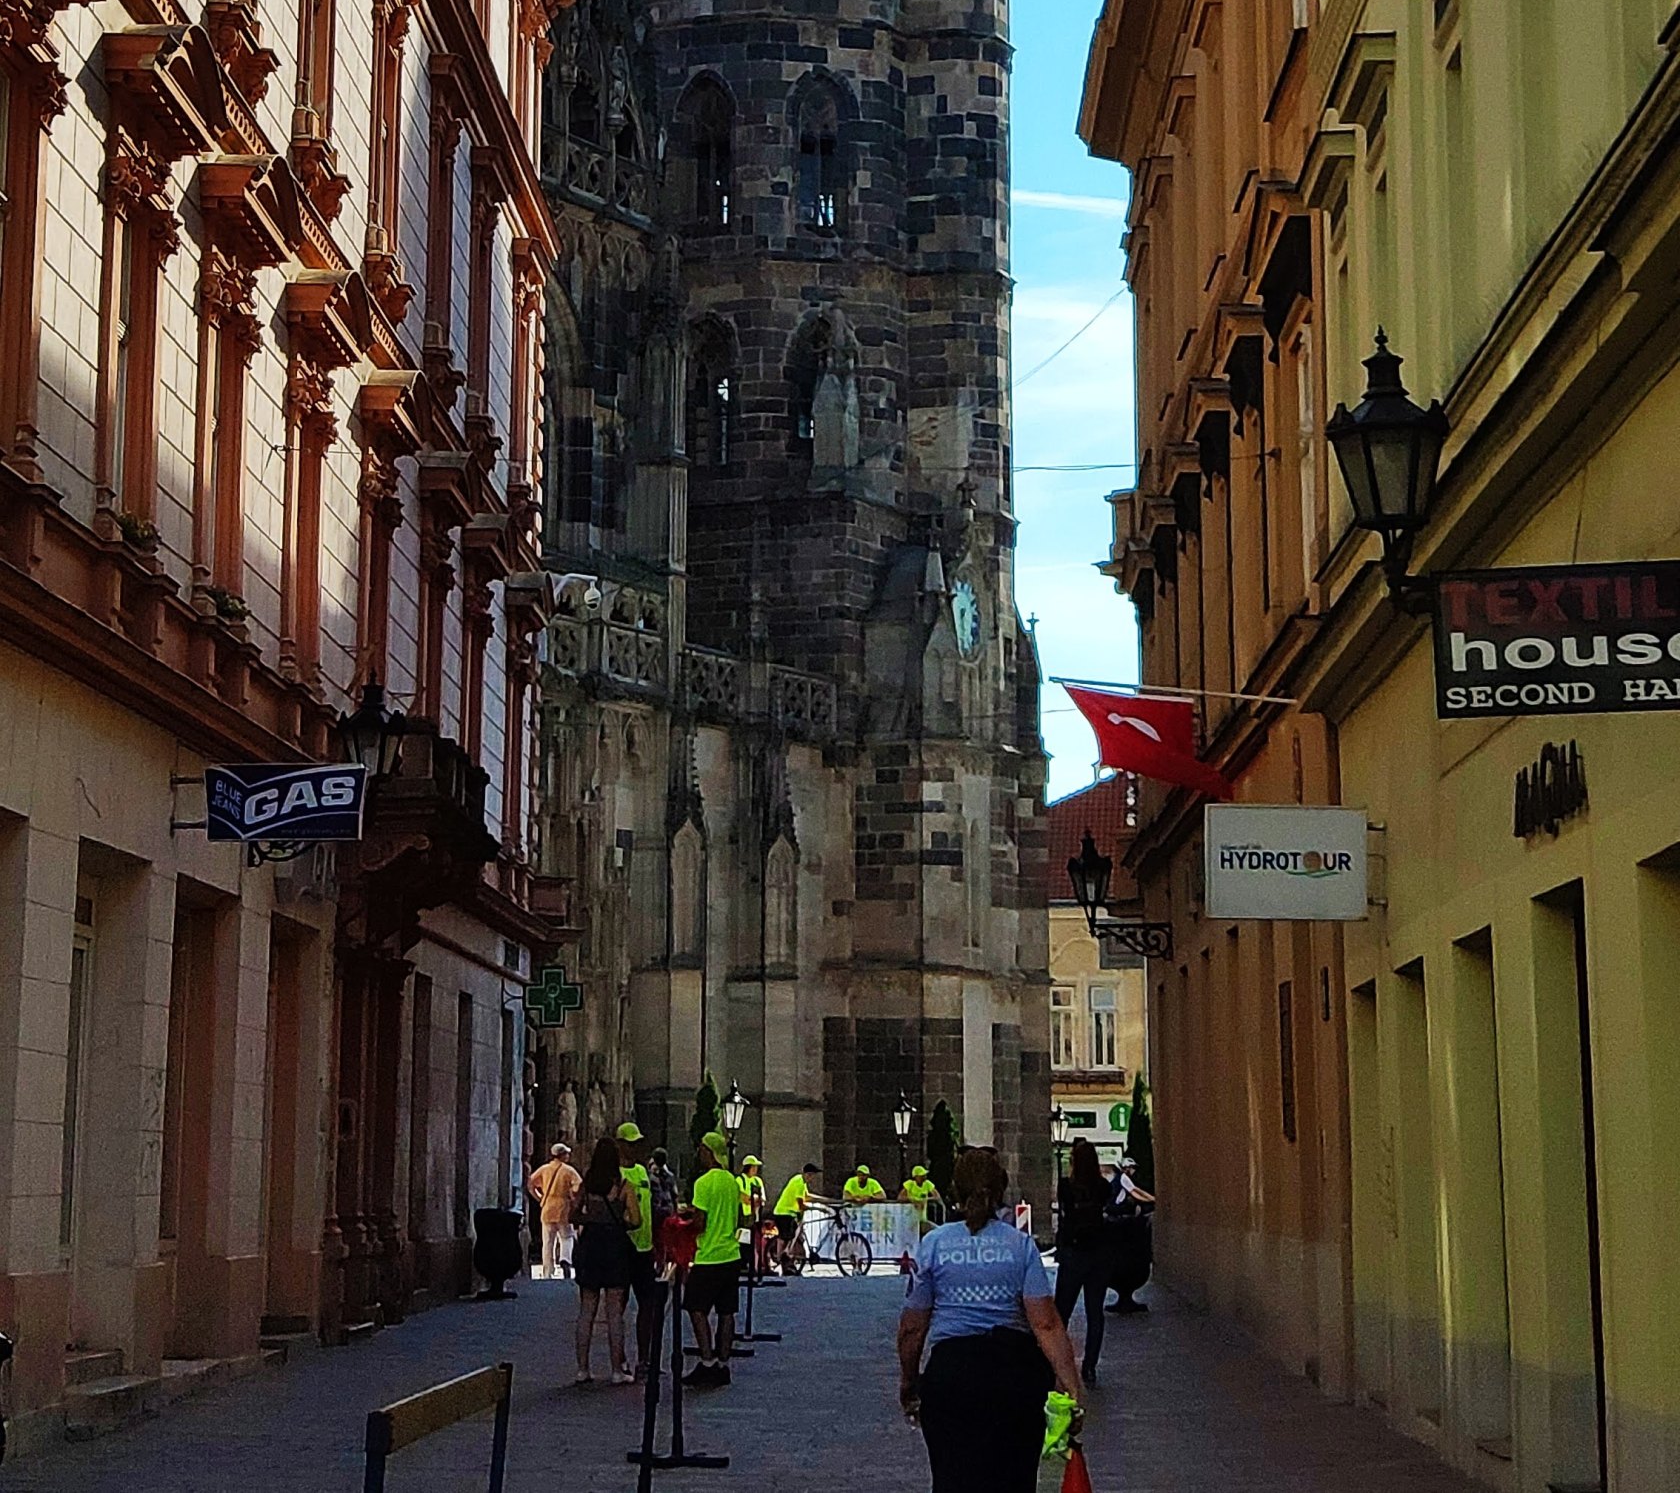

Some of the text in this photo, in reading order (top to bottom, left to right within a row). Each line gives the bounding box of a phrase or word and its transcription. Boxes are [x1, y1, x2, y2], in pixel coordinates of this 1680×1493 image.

[1440, 575, 1677, 629] TEXTIL
[1450, 631, 1680, 673] hous
[1446, 682, 1596, 709] SECOND
[215, 779, 243, 806] BLUE
[244, 776, 356, 825] GAS
[211, 794, 242, 821] JEANS
[1220, 851, 1352, 872] HYDROTOUR
